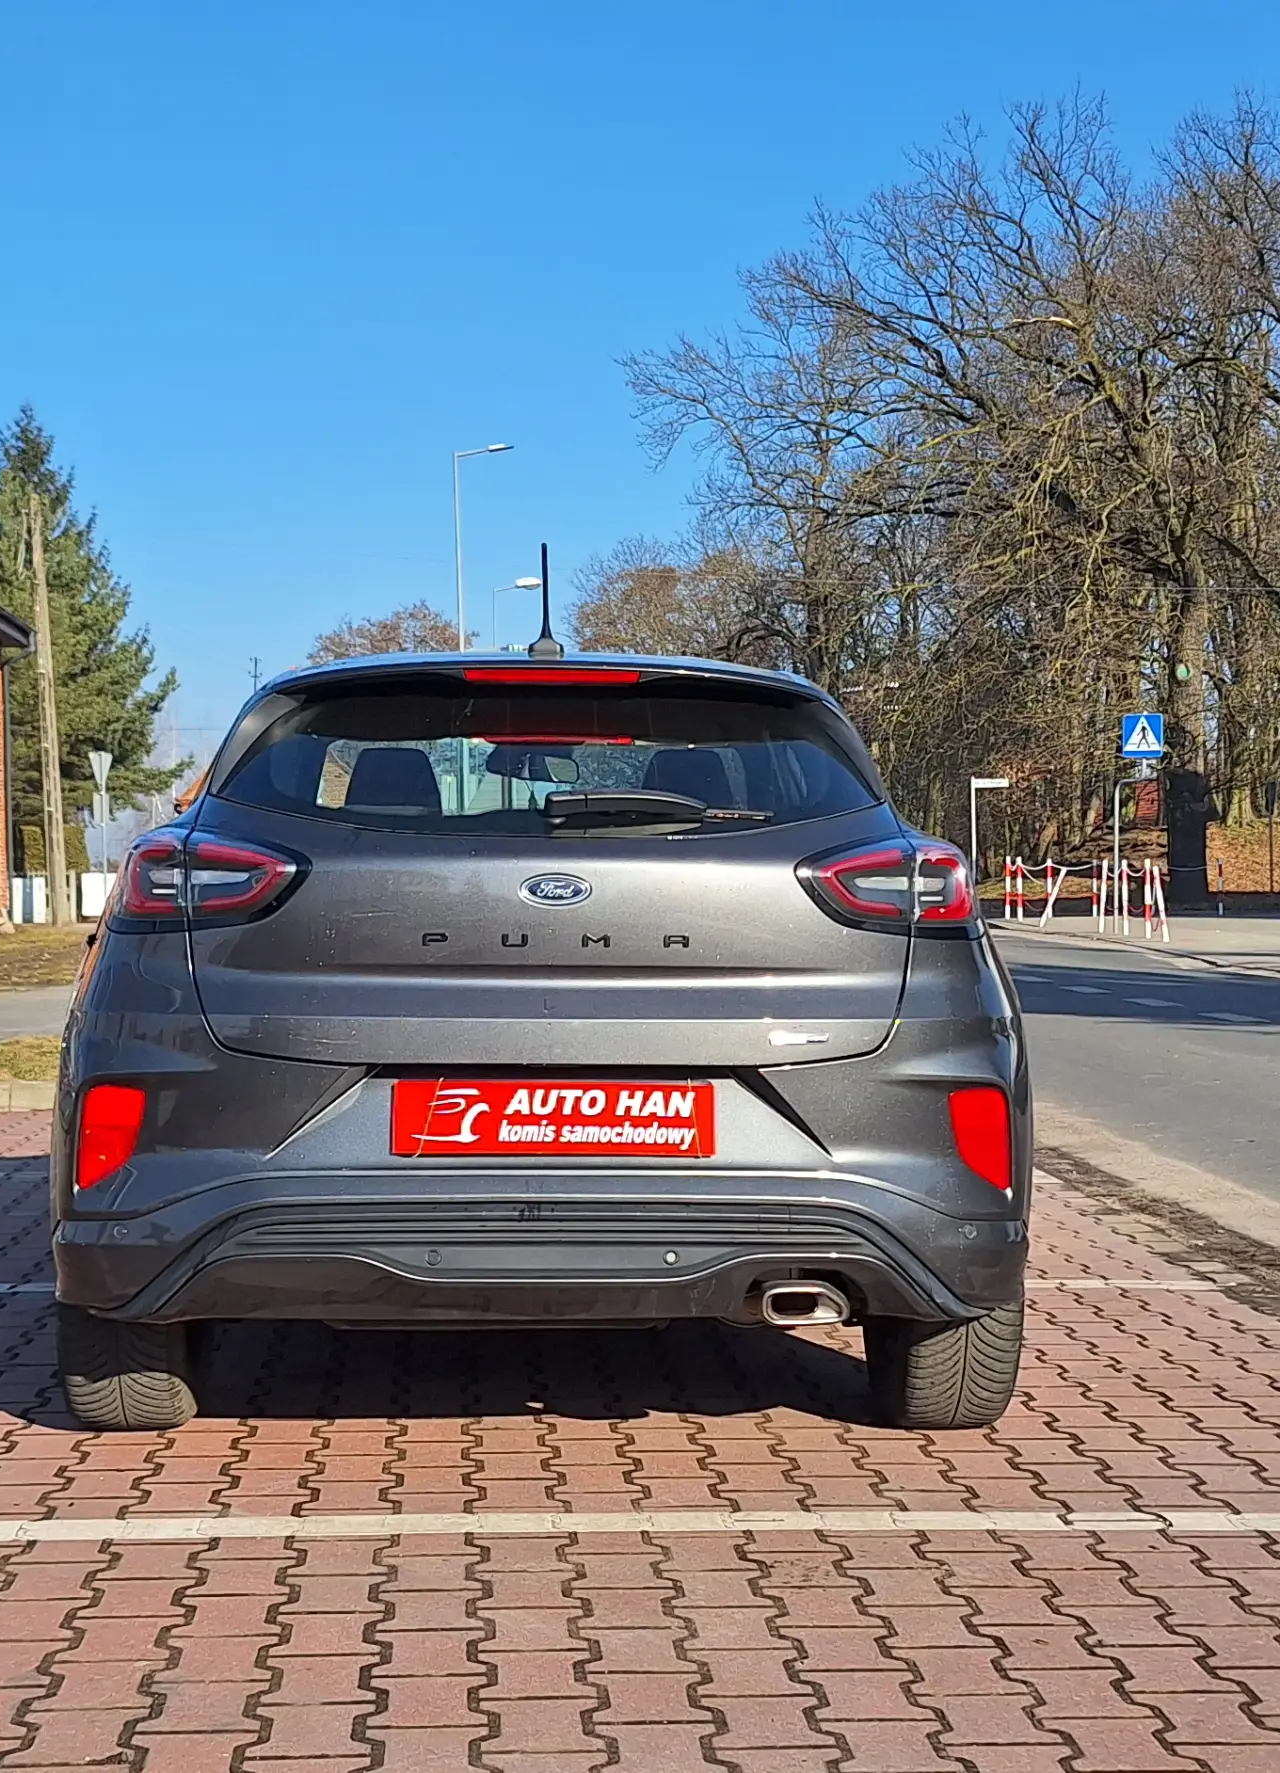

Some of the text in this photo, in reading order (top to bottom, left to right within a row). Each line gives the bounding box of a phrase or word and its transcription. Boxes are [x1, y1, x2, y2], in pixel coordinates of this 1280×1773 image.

[537, 881, 575, 899] Ford
[421, 932, 690, 949] PUMA
[504, 1088, 696, 1118] AUTO HAN
[498, 1119, 697, 1150] komis samochodowy
